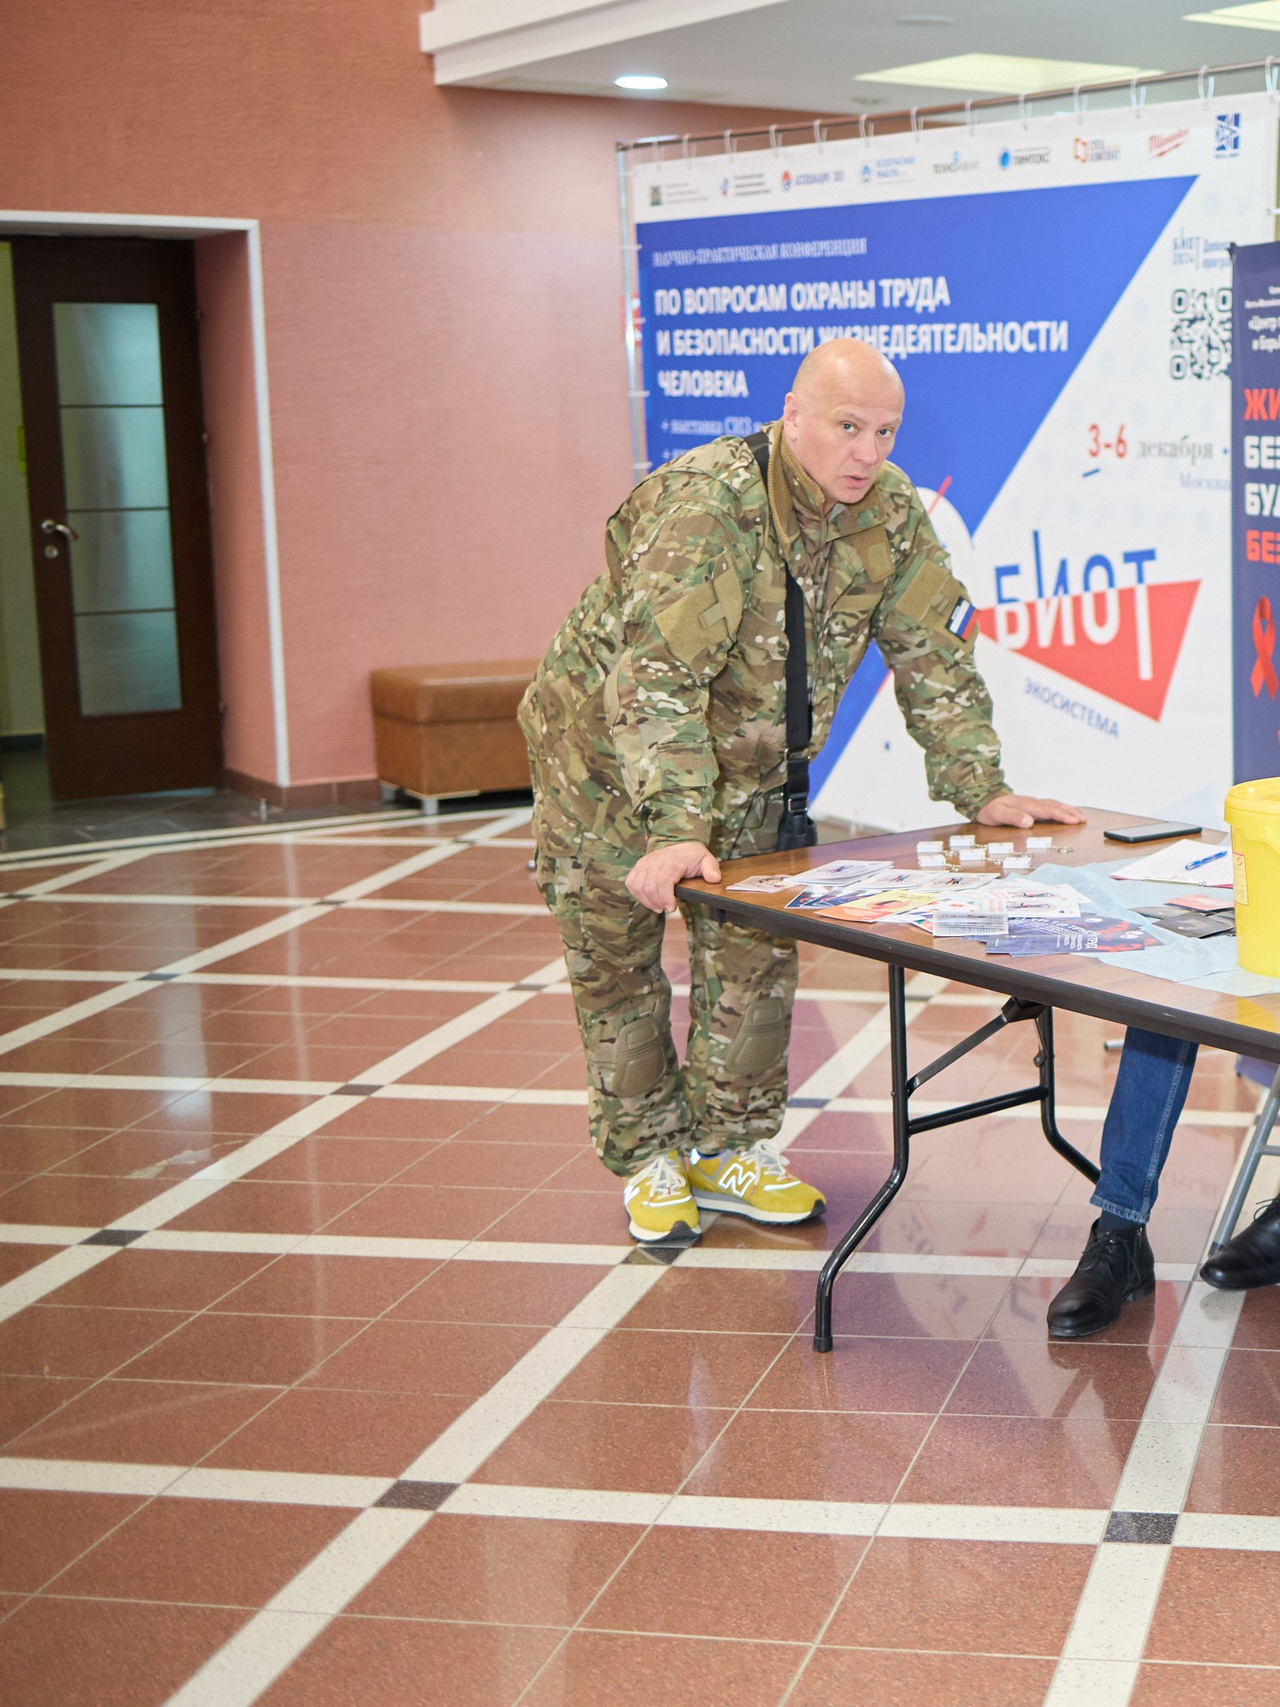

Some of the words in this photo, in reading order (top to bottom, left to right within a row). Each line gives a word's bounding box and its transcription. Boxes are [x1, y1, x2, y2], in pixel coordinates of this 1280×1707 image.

[654, 288, 681, 316] ПО
[683, 284, 788, 315] ВОПРОСАМ
[790, 279, 876, 311] ОХРАНЫ
[879, 276, 951, 314] ТРУДА
[656, 330, 670, 356] И
[673, 327, 815, 357] БЕЗОПАСНОСТИ
[657, 369, 749, 398] ЧЕЛОВЕКА
[1088, 423, 1128, 459] 3-6
[994, 529, 1156, 681] БИОТ
[1024, 677, 1119, 739] ЭКОСИСТЕМА
